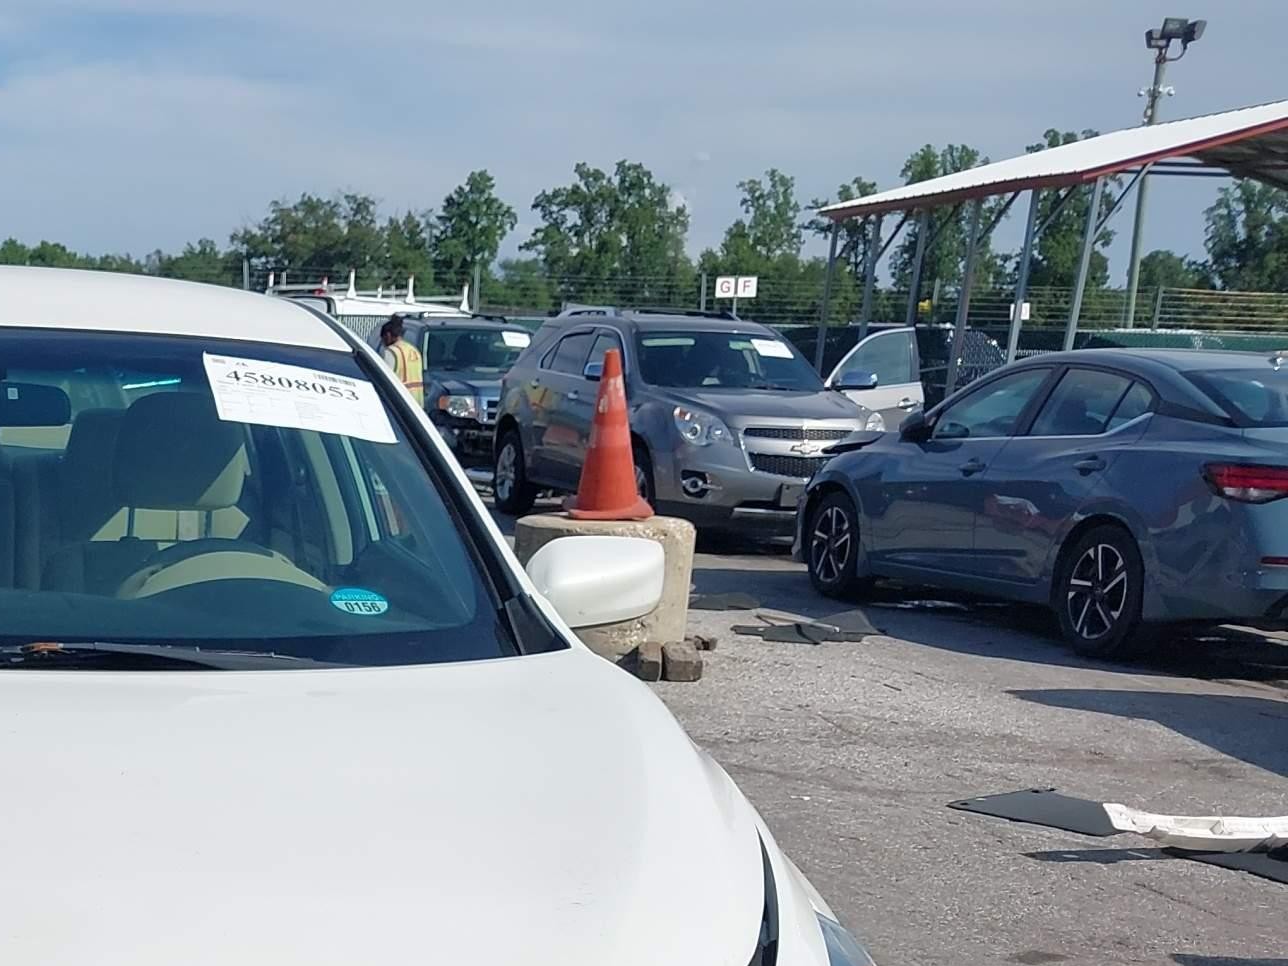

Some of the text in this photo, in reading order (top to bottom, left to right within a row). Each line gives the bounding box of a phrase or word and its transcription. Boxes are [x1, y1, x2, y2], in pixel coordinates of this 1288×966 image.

[720, 280, 731, 293] G
[743, 280, 752, 293] F
[226, 370, 360, 401] 45808053
[344, 602, 381, 612] 0156
